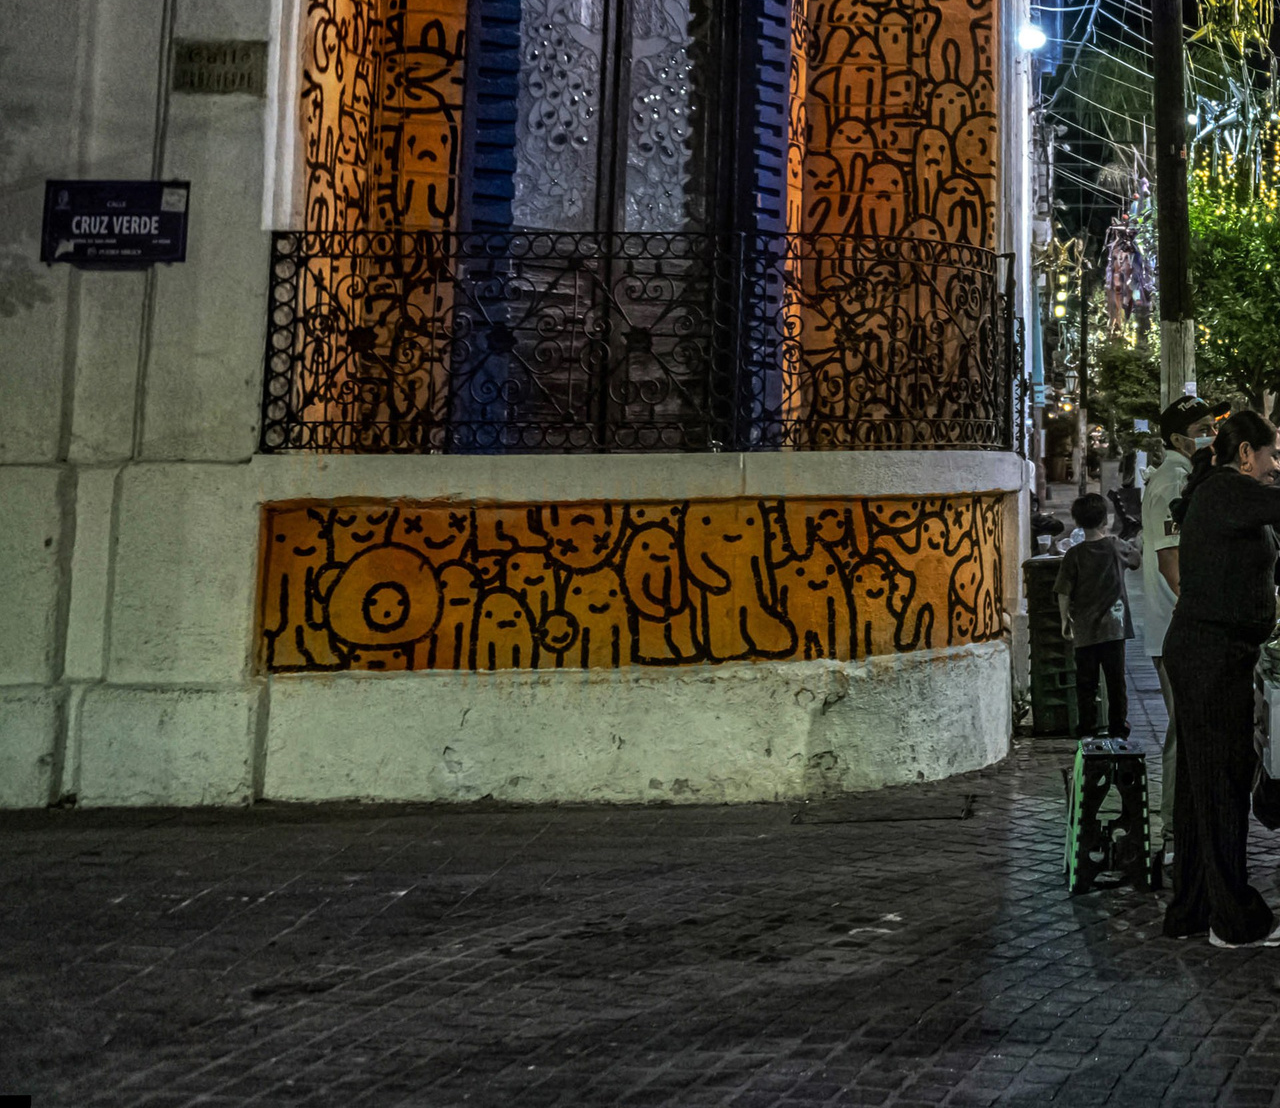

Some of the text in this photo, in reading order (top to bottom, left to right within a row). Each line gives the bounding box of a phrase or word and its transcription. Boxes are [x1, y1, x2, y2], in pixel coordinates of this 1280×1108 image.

[106, 200, 127, 208] CALLE
[71, 215, 160, 234] CRUZ VERDE
